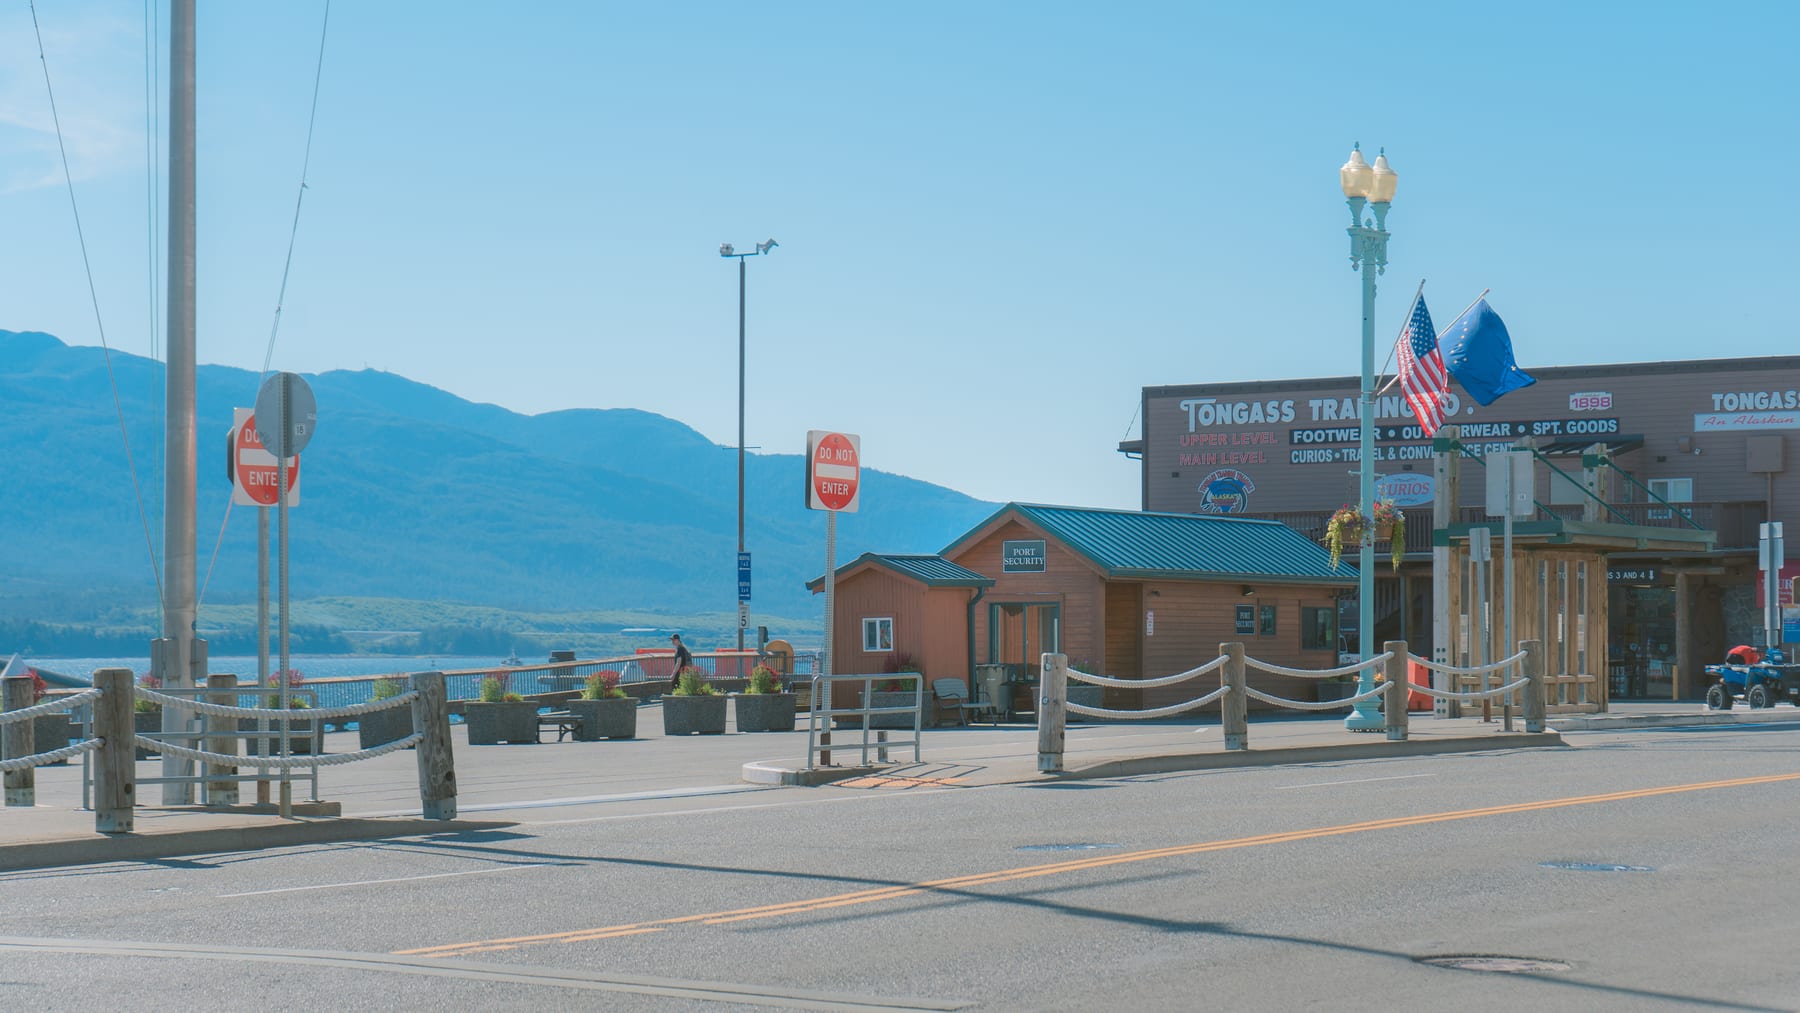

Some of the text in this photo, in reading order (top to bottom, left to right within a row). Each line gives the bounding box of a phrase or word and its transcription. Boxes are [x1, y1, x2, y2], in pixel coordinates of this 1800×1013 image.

[1573, 398, 1616, 411] 1898
[1711, 390, 1800, 412] TONGAS
[1179, 398, 1296, 433] TONGASS
[1703, 413, 1796, 426] An Alaskan
[1293, 427, 1382, 443] FOOTWER
[1532, 421, 1563, 435] SPT.
[1566, 418, 1618, 434] GOODS
[1179, 431, 1279, 447] UPPER LEVEL
[819, 446, 854, 462] DO NOT
[1178, 450, 1268, 466] MAIN LEVEL
[1341, 446, 1385, 462] TRAEL
[1387, 446, 1396, 460] &
[249, 471, 279, 486] ENTE
[821, 481, 849, 497] ENTER
[1013, 547, 1036, 556] PORT
[1003, 557, 1044, 566] SECURITY
[1615, 572, 1622, 580] 3
[1623, 572, 1638, 580] AND
[1640, 572, 1646, 580] 4
[740, 615, 747, 627] 5
